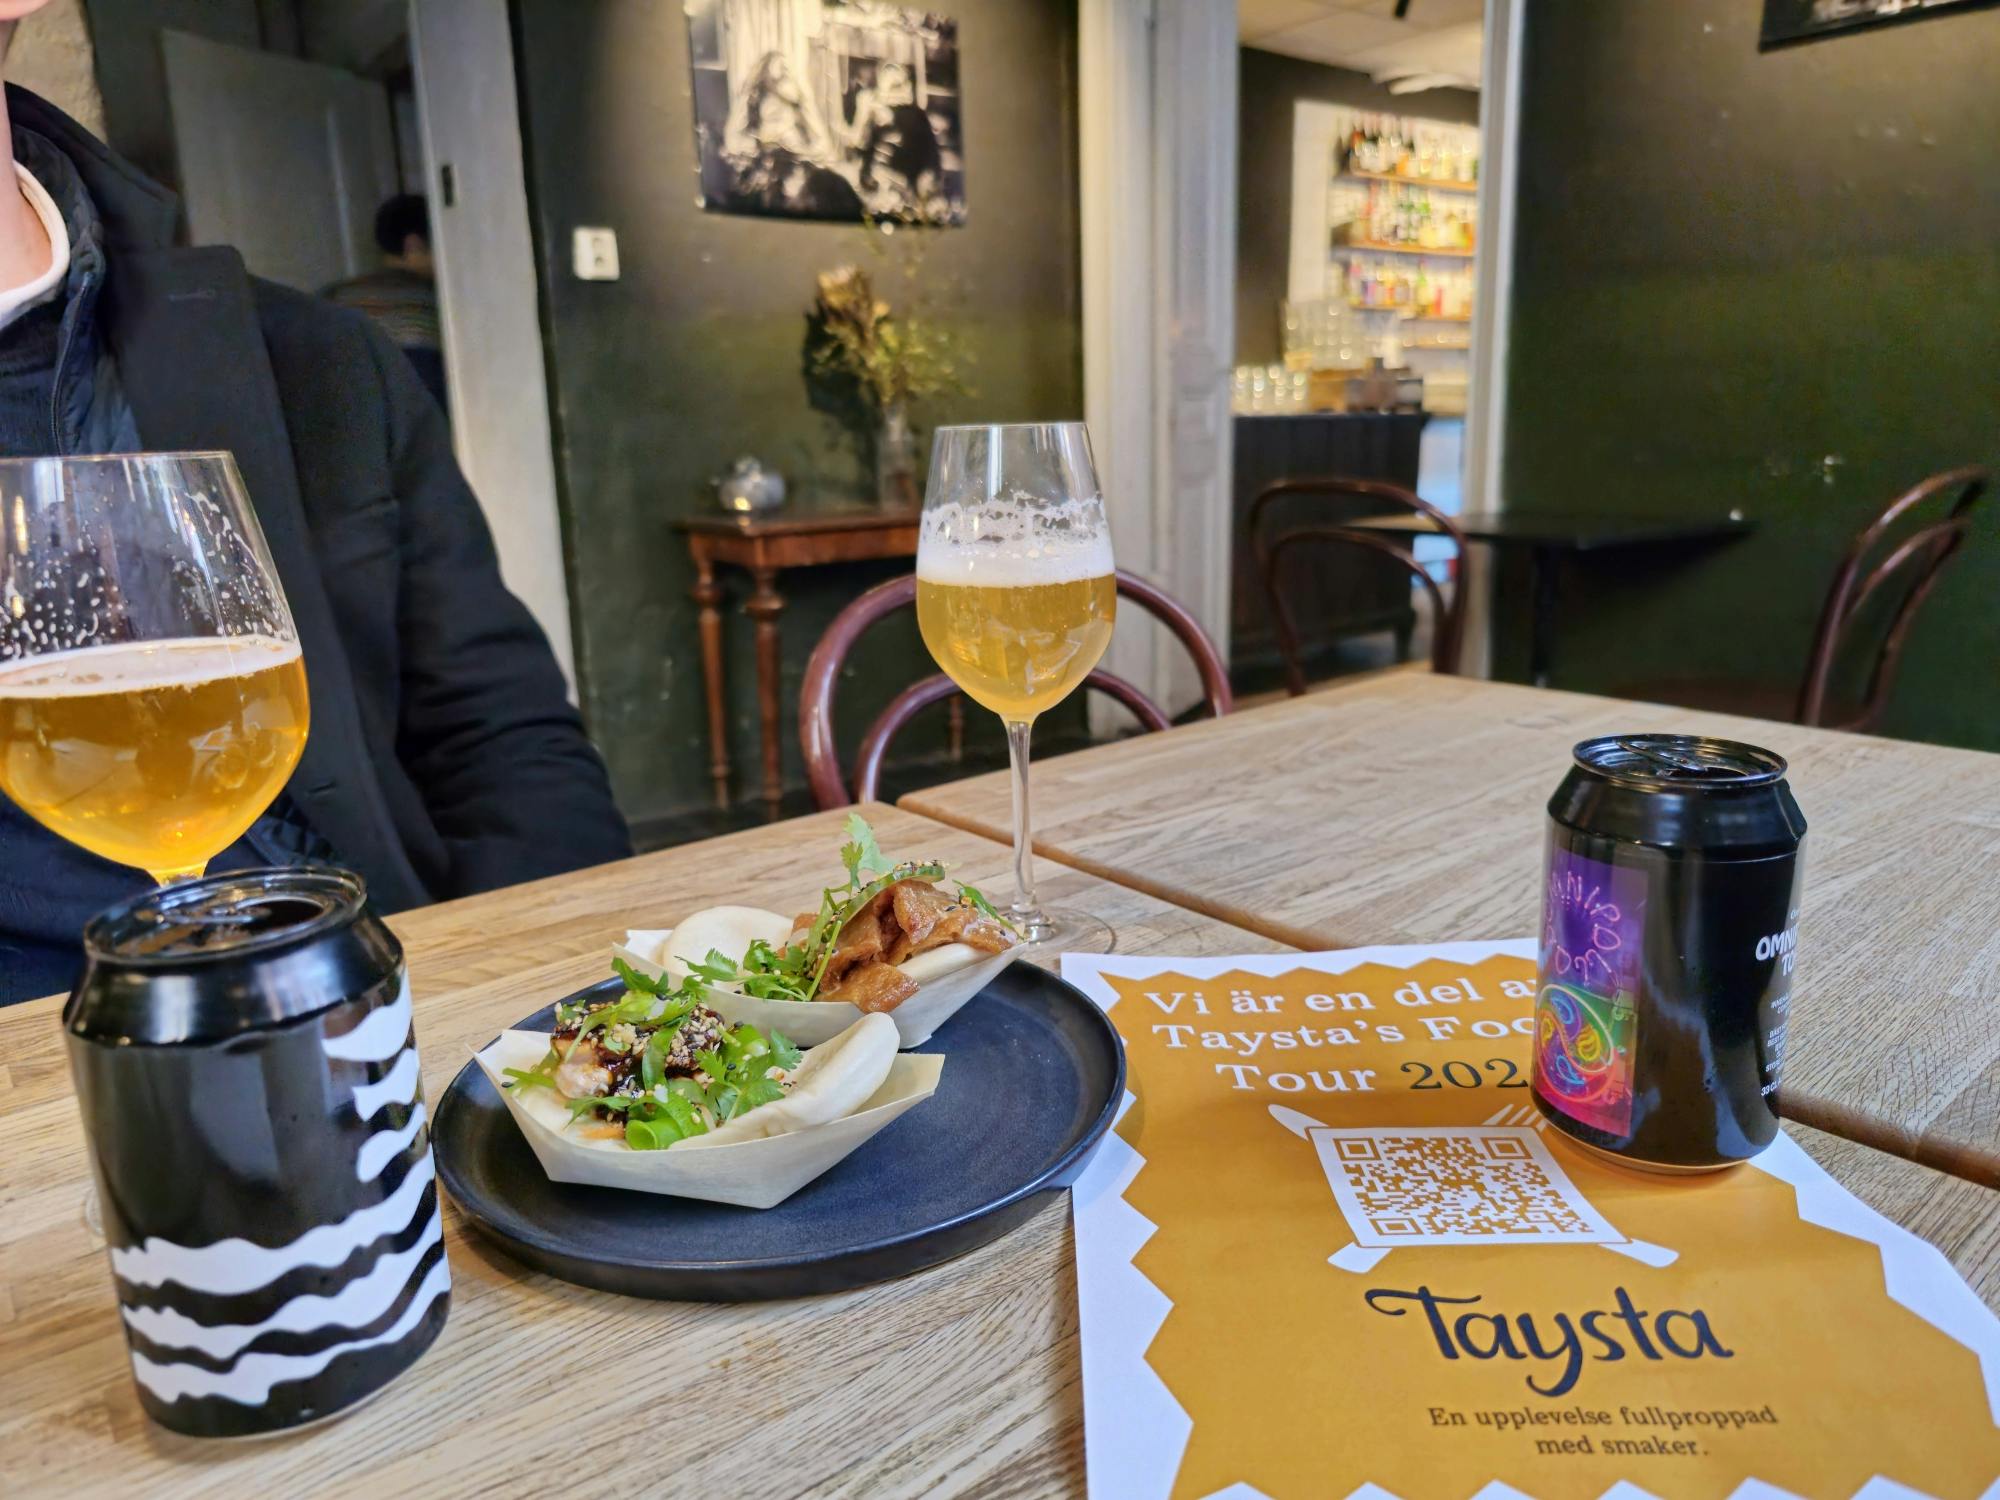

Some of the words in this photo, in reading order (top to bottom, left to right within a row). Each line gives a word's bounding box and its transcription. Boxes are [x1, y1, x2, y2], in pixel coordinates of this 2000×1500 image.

[1144, 990, 1211, 1015] Vi
[1232, 989, 1285, 1014] är
[1305, 991, 1373, 1012] en
[1393, 977, 1484, 1008] del
[1152, 1018, 1406, 1057] Taysta's
[1418, 1015, 1536, 1041] Foo
[1216, 1063, 1377, 1093] Tour
[1400, 1057, 1529, 1090] 202
[1364, 1285, 1735, 1398] Taysta
[1428, 1407, 1468, 1427] En
[1474, 1405, 1613, 1430] upplevelse
[1620, 1404, 1778, 1430] fullproppad
[1536, 1434, 1594, 1455] med
[1602, 1434, 1710, 1457] smaker.
